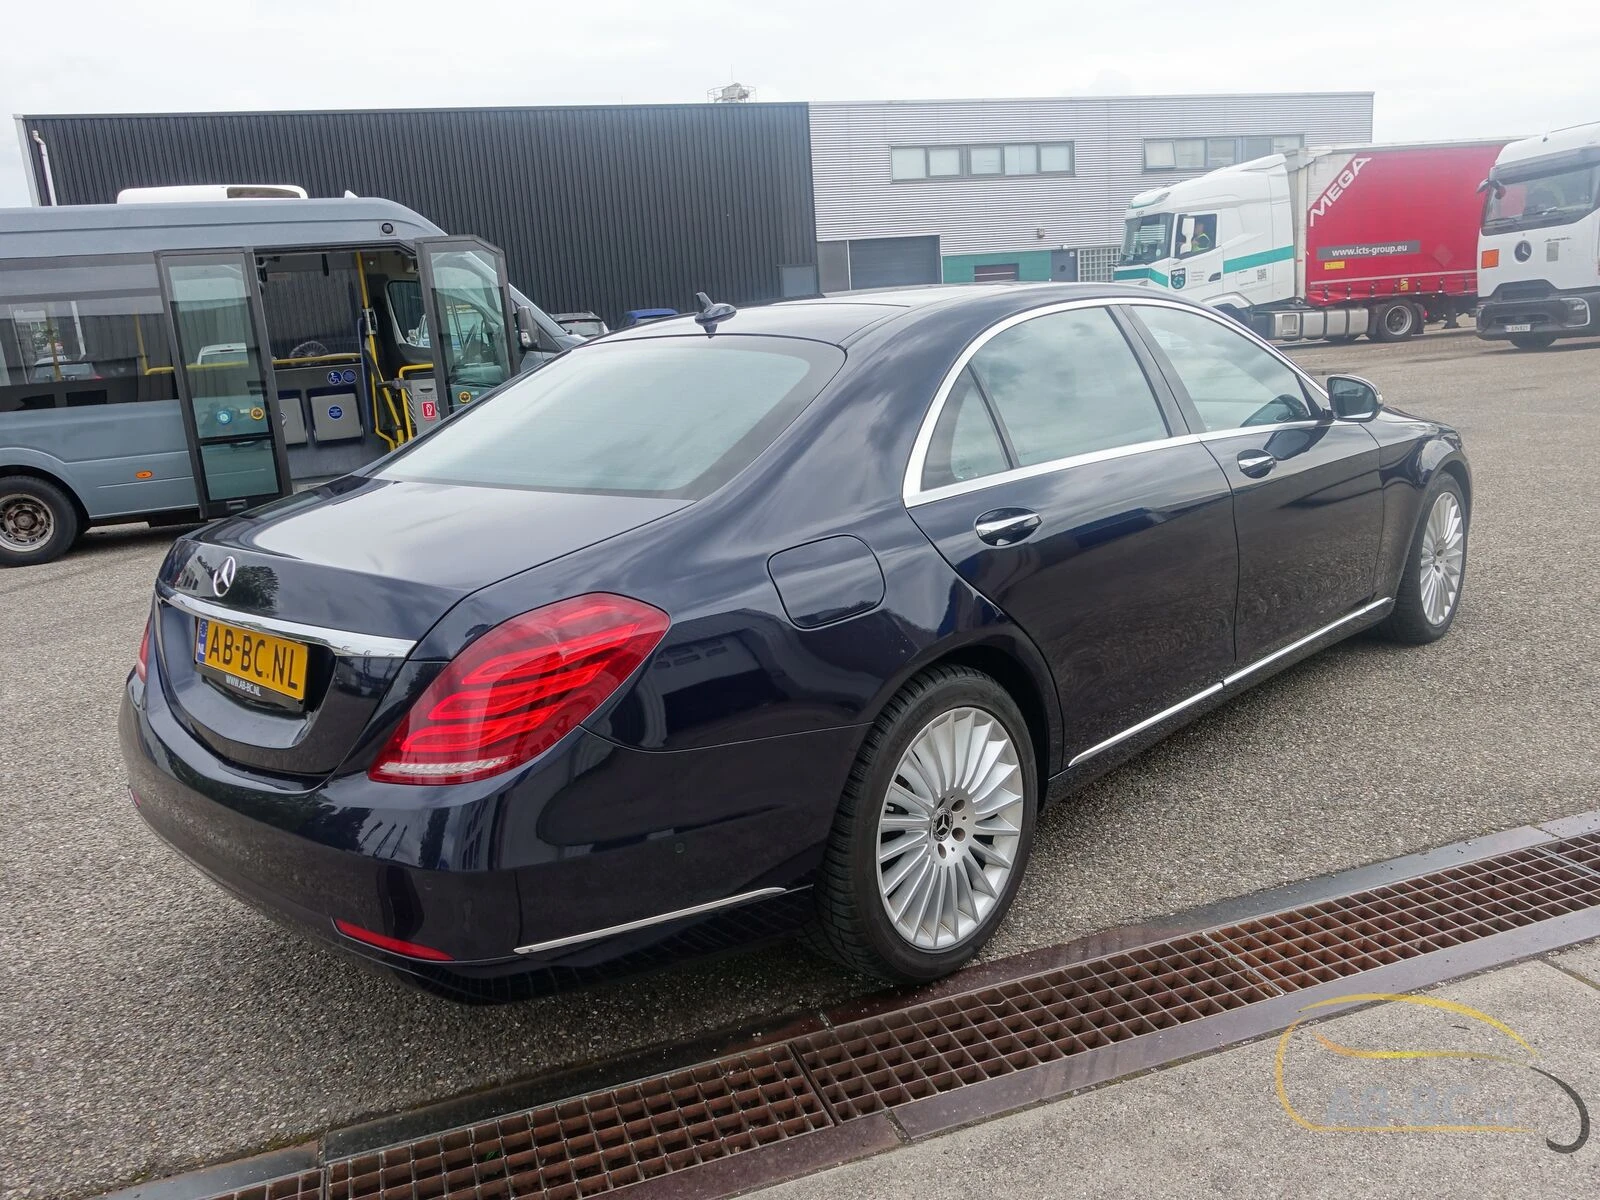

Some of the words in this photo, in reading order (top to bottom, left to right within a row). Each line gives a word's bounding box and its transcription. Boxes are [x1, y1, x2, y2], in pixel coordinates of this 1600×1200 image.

[1310, 157, 1372, 227] MEGA
[1331, 244, 1408, 256] www.icts-group.eu
[209, 626, 298, 690] AB-BC.NL
